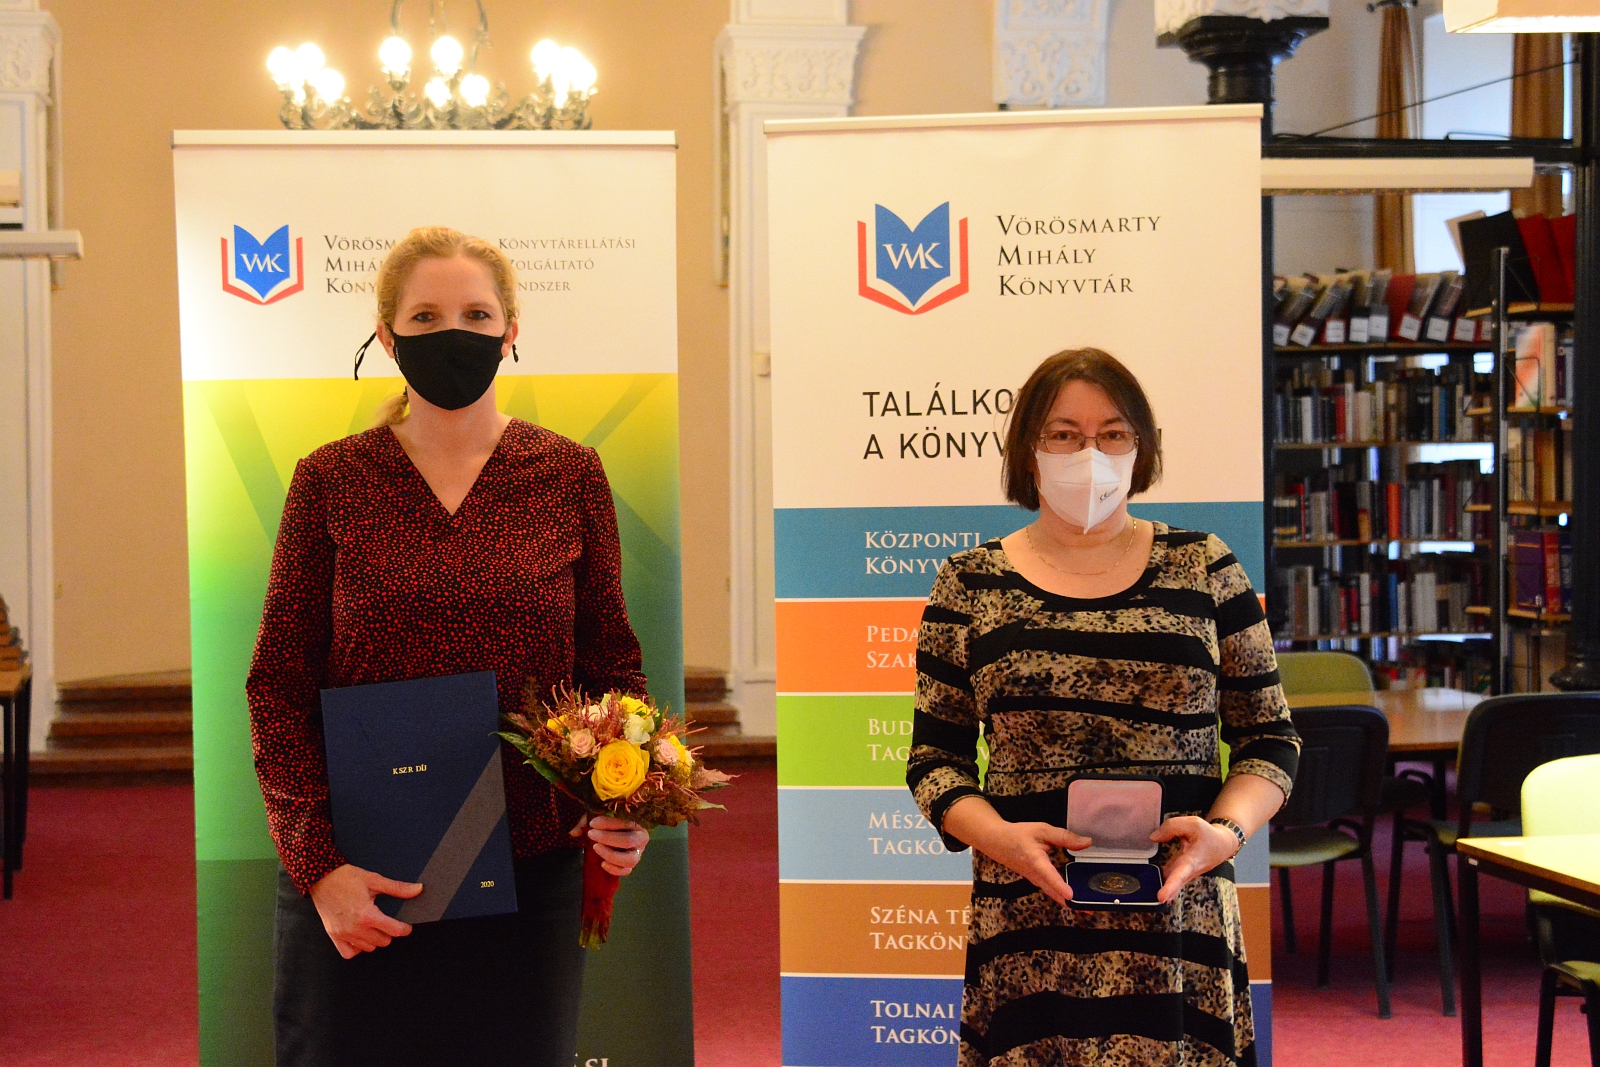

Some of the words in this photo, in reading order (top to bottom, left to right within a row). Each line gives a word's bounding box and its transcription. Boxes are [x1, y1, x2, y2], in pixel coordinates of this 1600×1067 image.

[996, 214, 1162, 235] VÖRÖSMARTY
[323, 234, 397, 250] VÖRÖSM
[499, 237, 636, 249] KÖNYVTÁRELLÁTÁSI
[325, 257, 383, 272] MIHÁ
[508, 257, 595, 270] OLGÁLTATÓ
[997, 245, 1097, 266] MIHÁLY
[326, 278, 377, 293] KÖNY
[518, 281, 571, 291] NDSZER
[998, 273, 1135, 296] KÖNYVTÁR
[862, 382, 1015, 417] TALÁLKO
[863, 433, 884, 460] A
[900, 426, 1005, 459] KÖNYV
[864, 530, 981, 549] KÖZPONTI
[865, 556, 945, 574] KÖNYV
[866, 625, 918, 643] PEDA
[866, 651, 916, 668] SZAK
[868, 718, 913, 736] BUD
[867, 743, 910, 761] TAG
[868, 810, 936, 829] MÉSZ
[868, 836, 945, 855] TAGKÖ
[870, 905, 939, 924] SZÉNA
[946, 905, 970, 925] TÉ
[869, 932, 968, 950] TAGKÖN
[870, 1000, 955, 1019] TOLNAI
[870, 1025, 961, 1044] TAGKÖN
